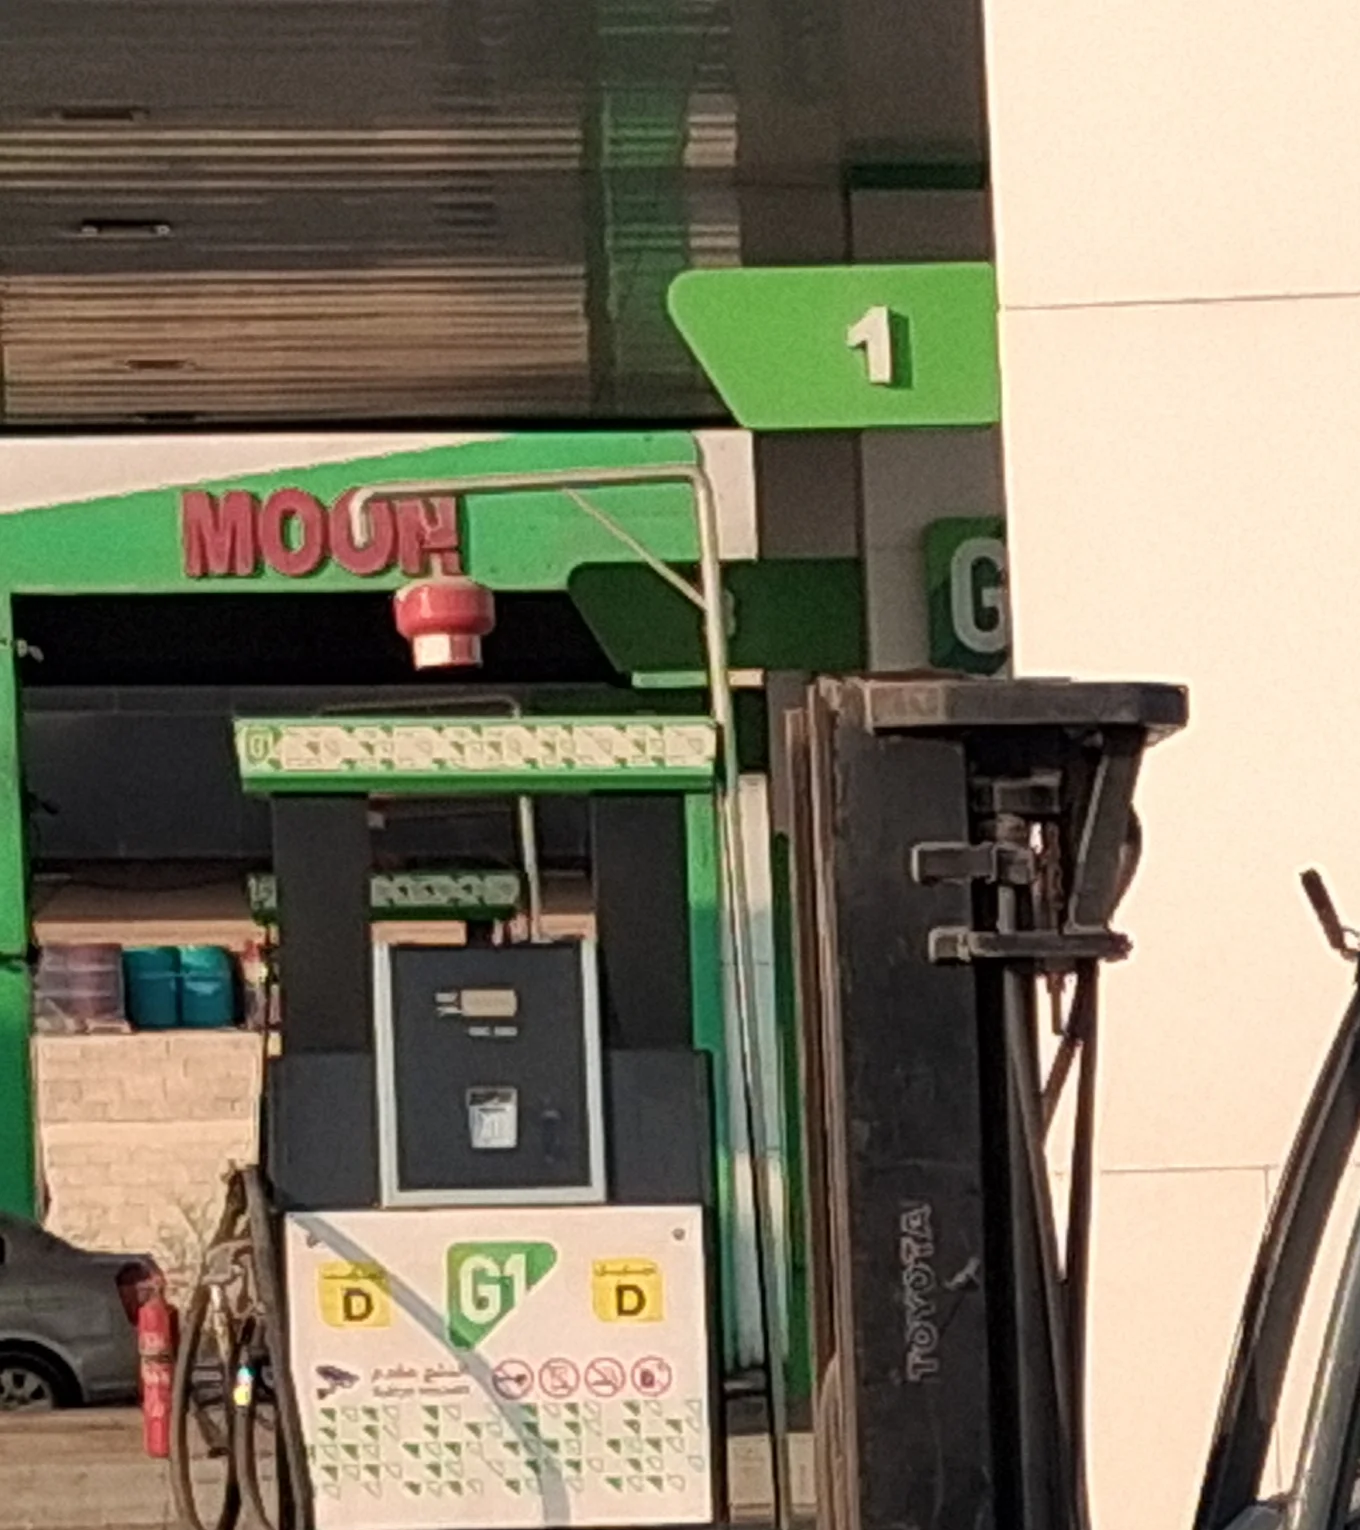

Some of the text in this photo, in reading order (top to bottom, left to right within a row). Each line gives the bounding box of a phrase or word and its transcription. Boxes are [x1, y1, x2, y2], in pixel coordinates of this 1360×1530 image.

[846, 305, 892, 384] 1
[182, 487, 461, 577] MOON
[343, 1287, 375, 1322] D
[459, 1253, 526, 1325] G1
[615, 1284, 647, 1317] D
[901, 1203, 939, 1382] TOYOTA
